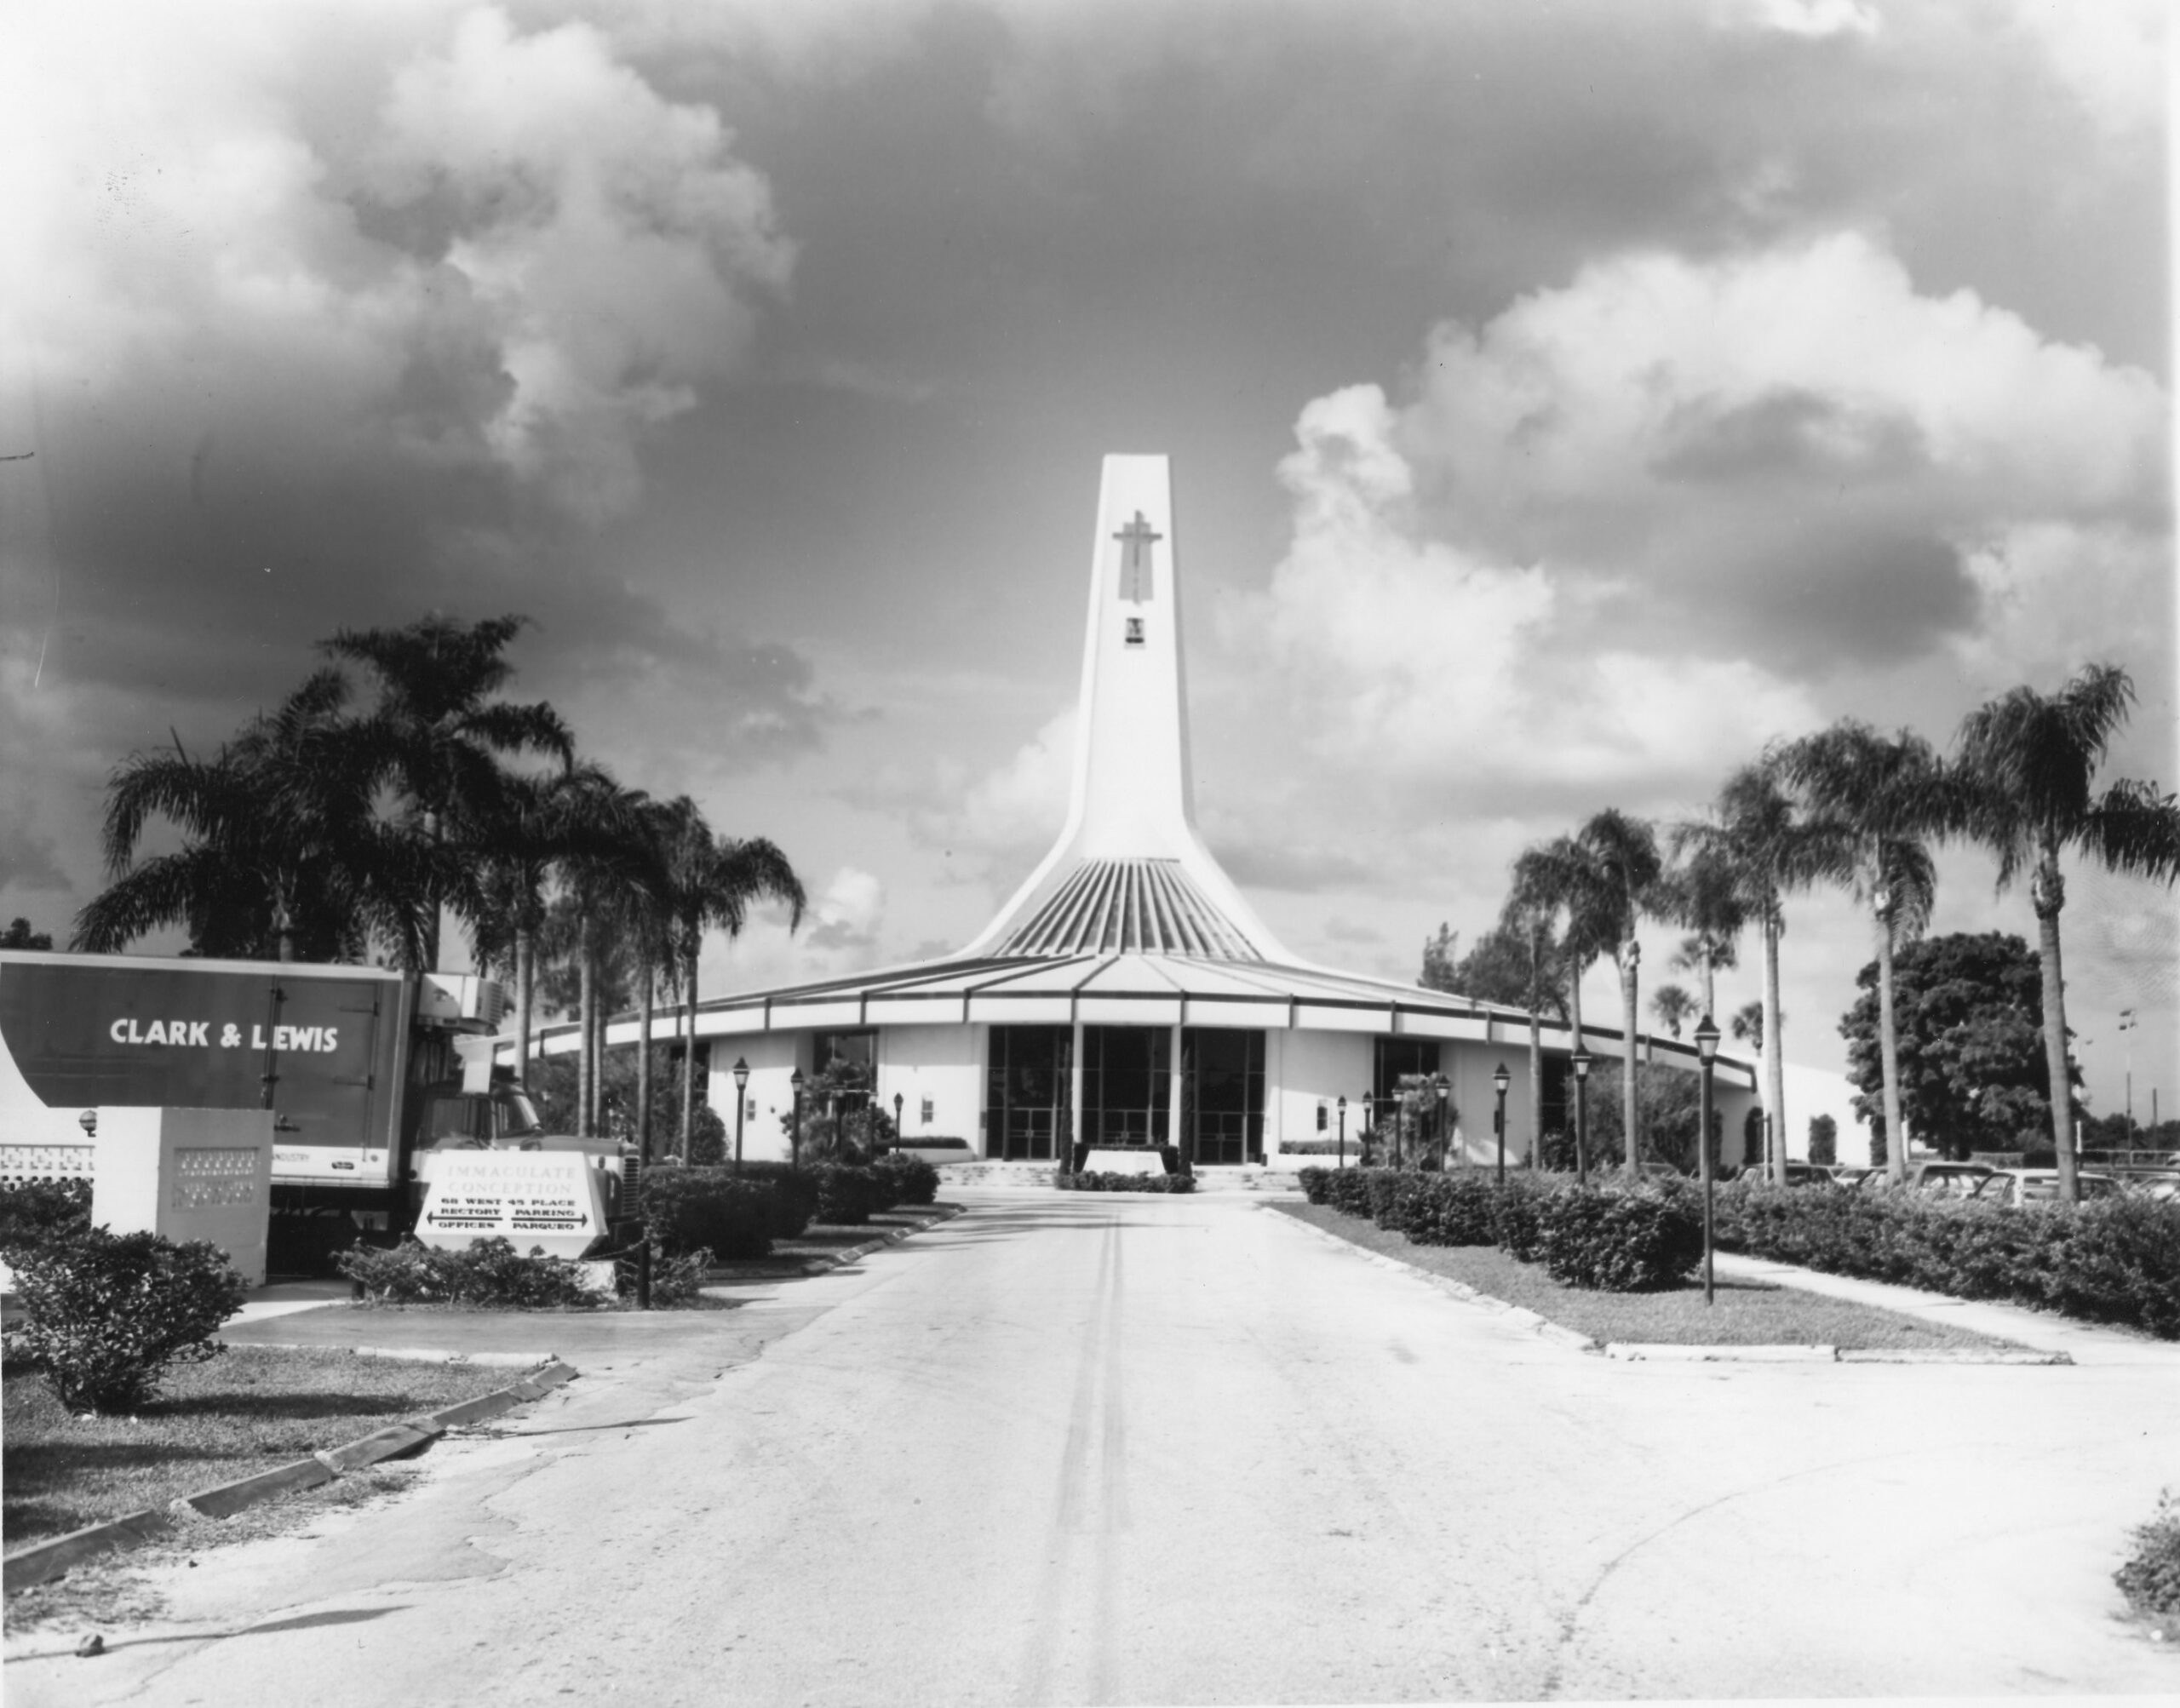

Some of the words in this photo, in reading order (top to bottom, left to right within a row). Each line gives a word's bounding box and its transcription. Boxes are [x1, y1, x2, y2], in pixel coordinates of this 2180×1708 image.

[110, 1018, 210, 1047] CLARK
[220, 1022, 242, 1048] &
[250, 1024, 339, 1053] LEWIS
[447, 1165, 576, 1179] IMMACULATE
[448, 1181, 572, 1195] CONCEPTION
[465, 1197, 502, 1206] WEST
[440, 1207, 501, 1216] RECTORY
